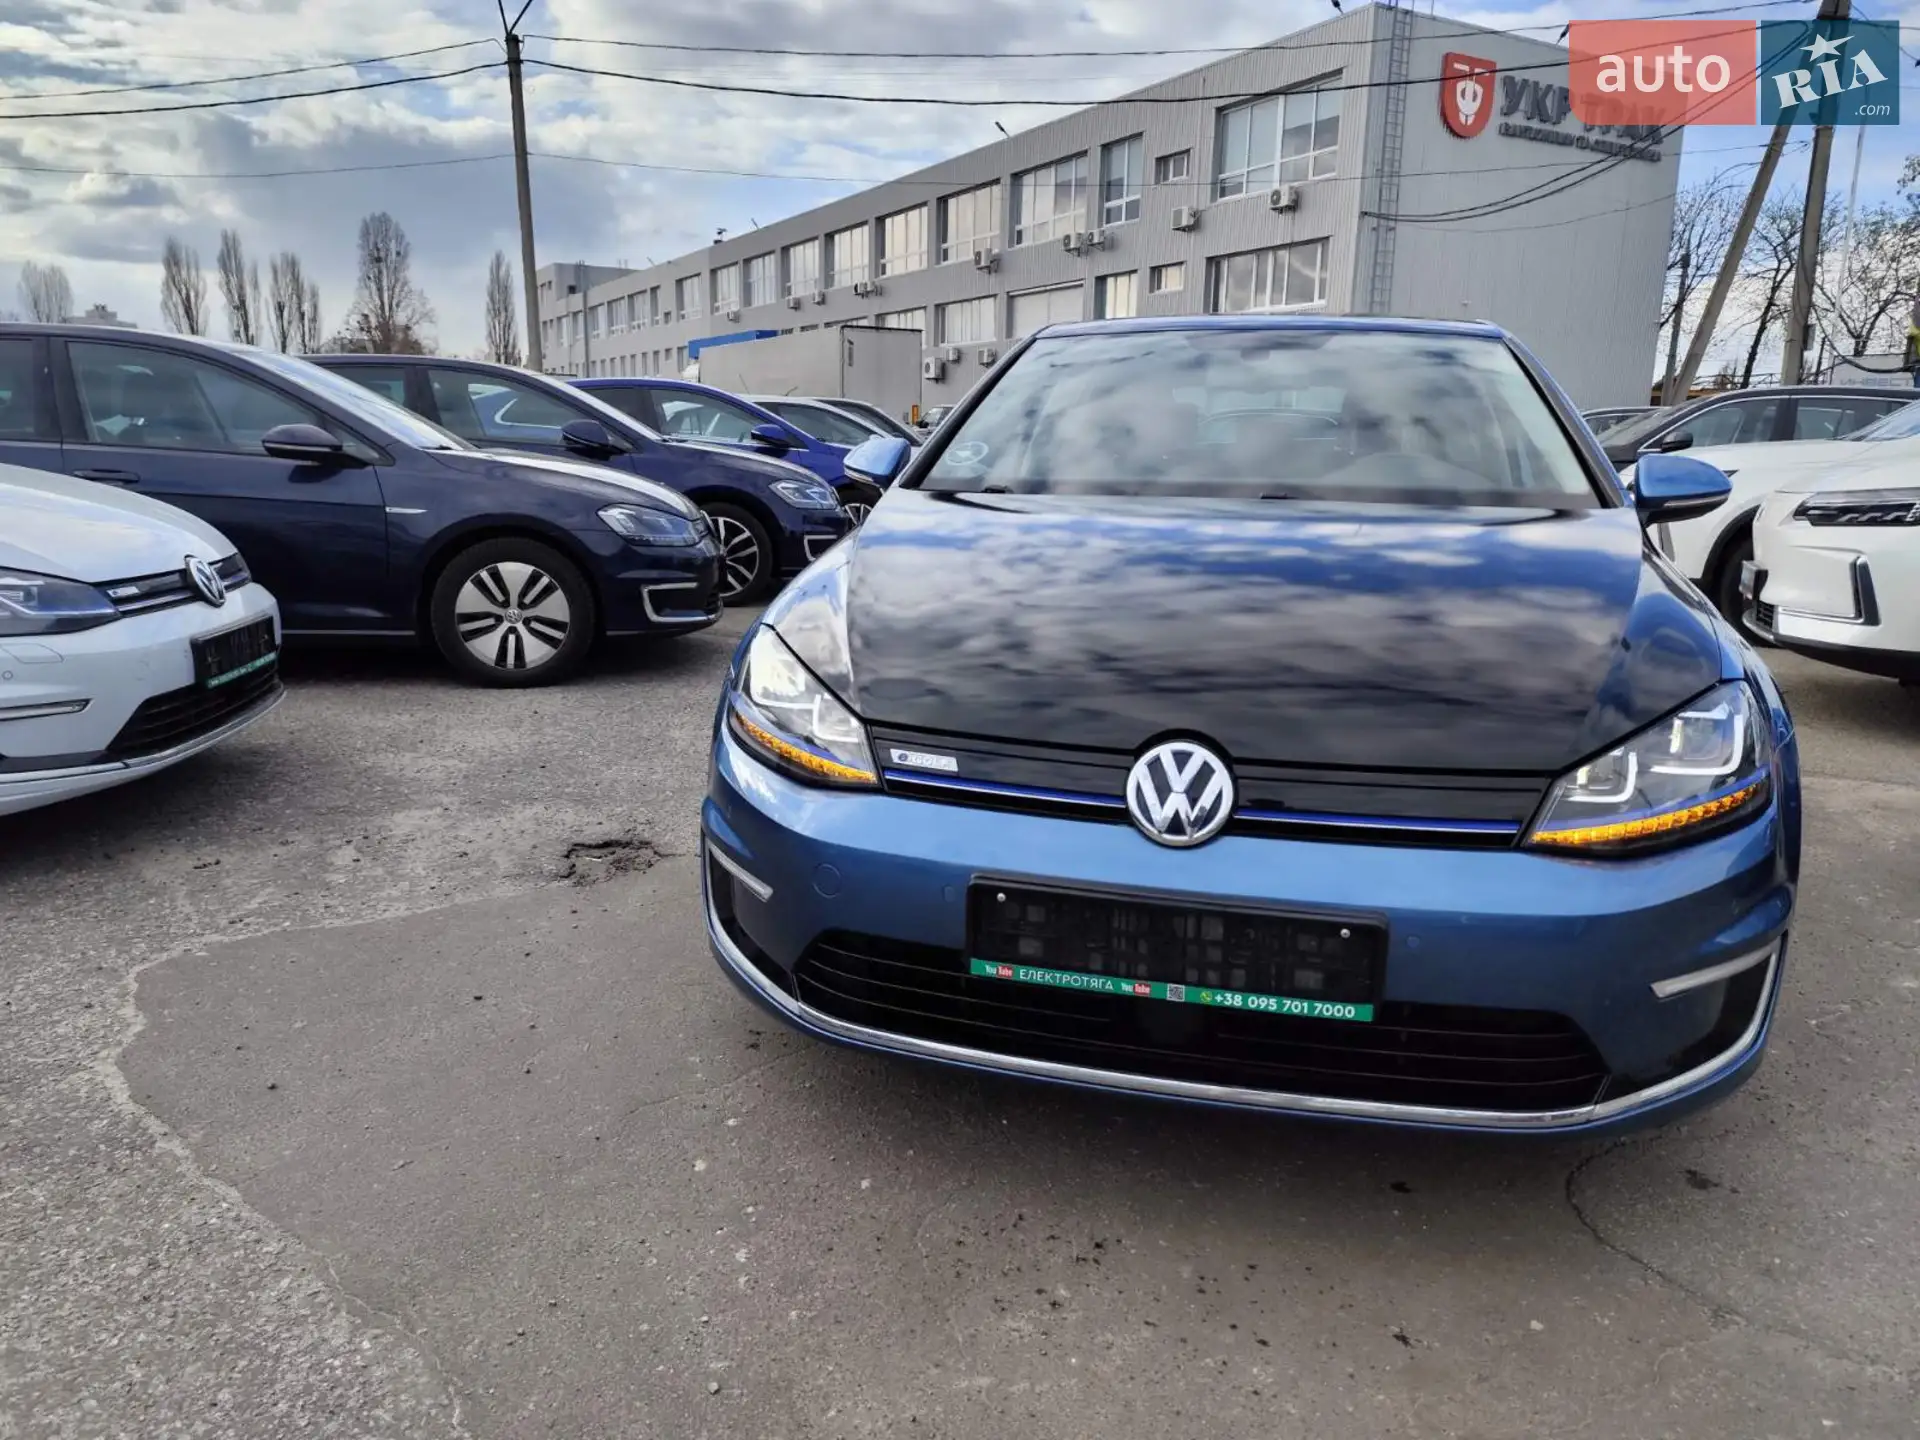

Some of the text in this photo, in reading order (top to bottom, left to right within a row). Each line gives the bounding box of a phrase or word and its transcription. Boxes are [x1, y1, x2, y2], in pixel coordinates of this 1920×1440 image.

[1127, 740, 1233, 846] VW
[1020, 969, 1114, 991] ЕЛЕКТРОТЯГА
[1214, 992, 1356, 1019] +38 095 701 7000
